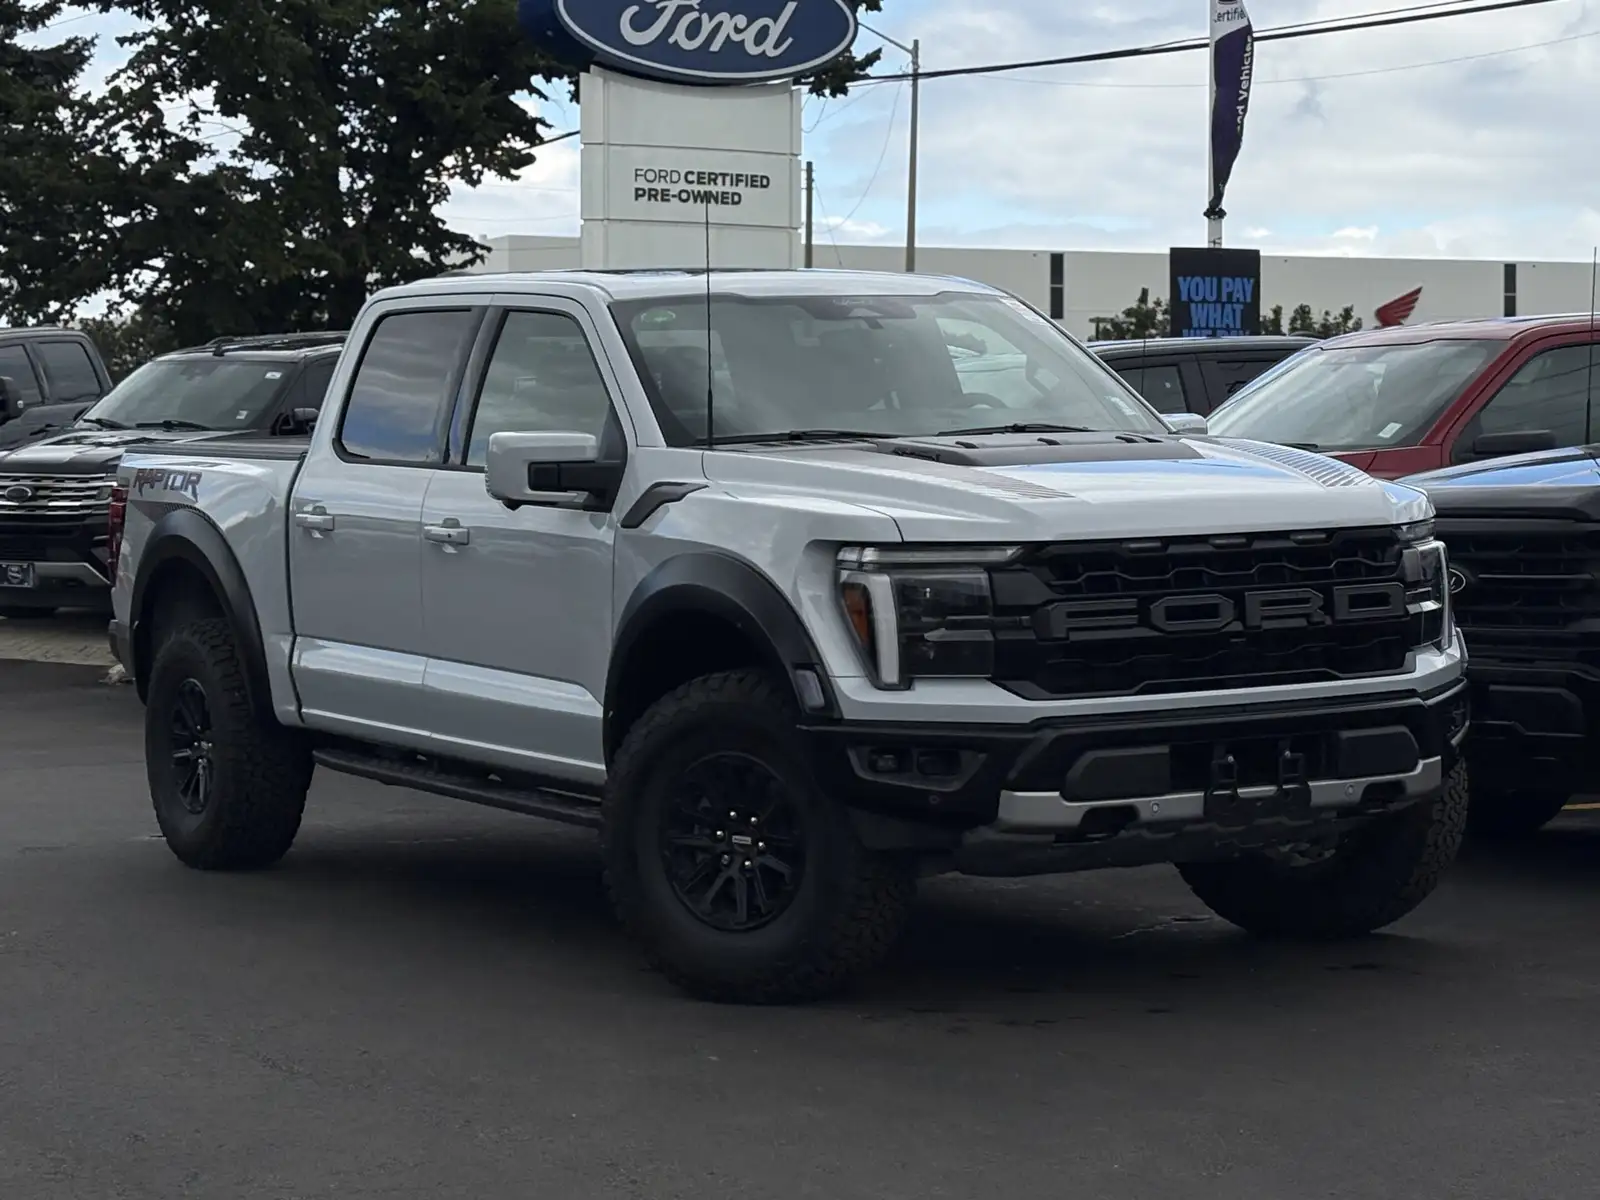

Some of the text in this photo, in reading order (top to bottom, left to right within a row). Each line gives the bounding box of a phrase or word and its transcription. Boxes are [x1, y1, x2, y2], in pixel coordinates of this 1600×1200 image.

[620, 0, 798, 57] Ford
[634, 168, 770, 189] FORD CERTIFIED
[634, 187, 742, 206] PRE-OWNED
[1177, 276, 1254, 302] YOU PAY
[1190, 302, 1244, 329] WHAT
[133, 468, 202, 503] RAPTOR
[1032, 581, 1405, 642] FORD
